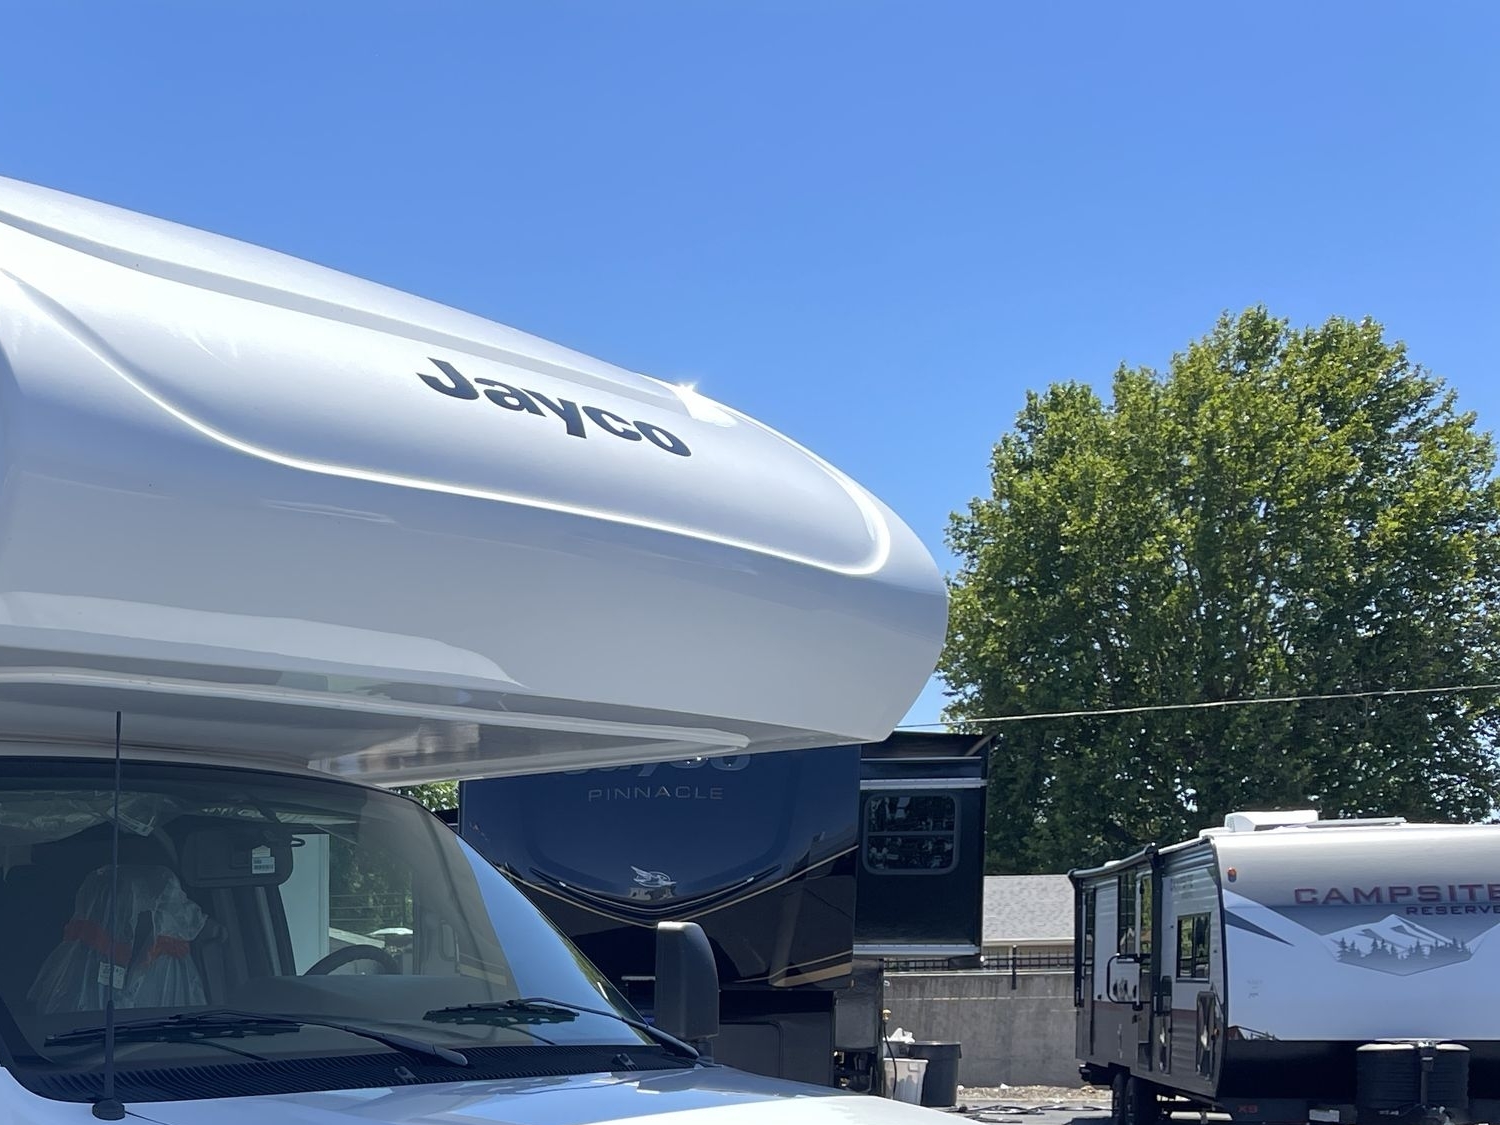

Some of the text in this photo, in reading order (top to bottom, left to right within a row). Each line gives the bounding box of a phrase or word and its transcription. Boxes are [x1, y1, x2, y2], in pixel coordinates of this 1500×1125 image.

[416, 357, 692, 457] Jayco
[588, 786, 724, 802] PINNACLE
[1294, 884, 1500, 904] CAMPSITE
